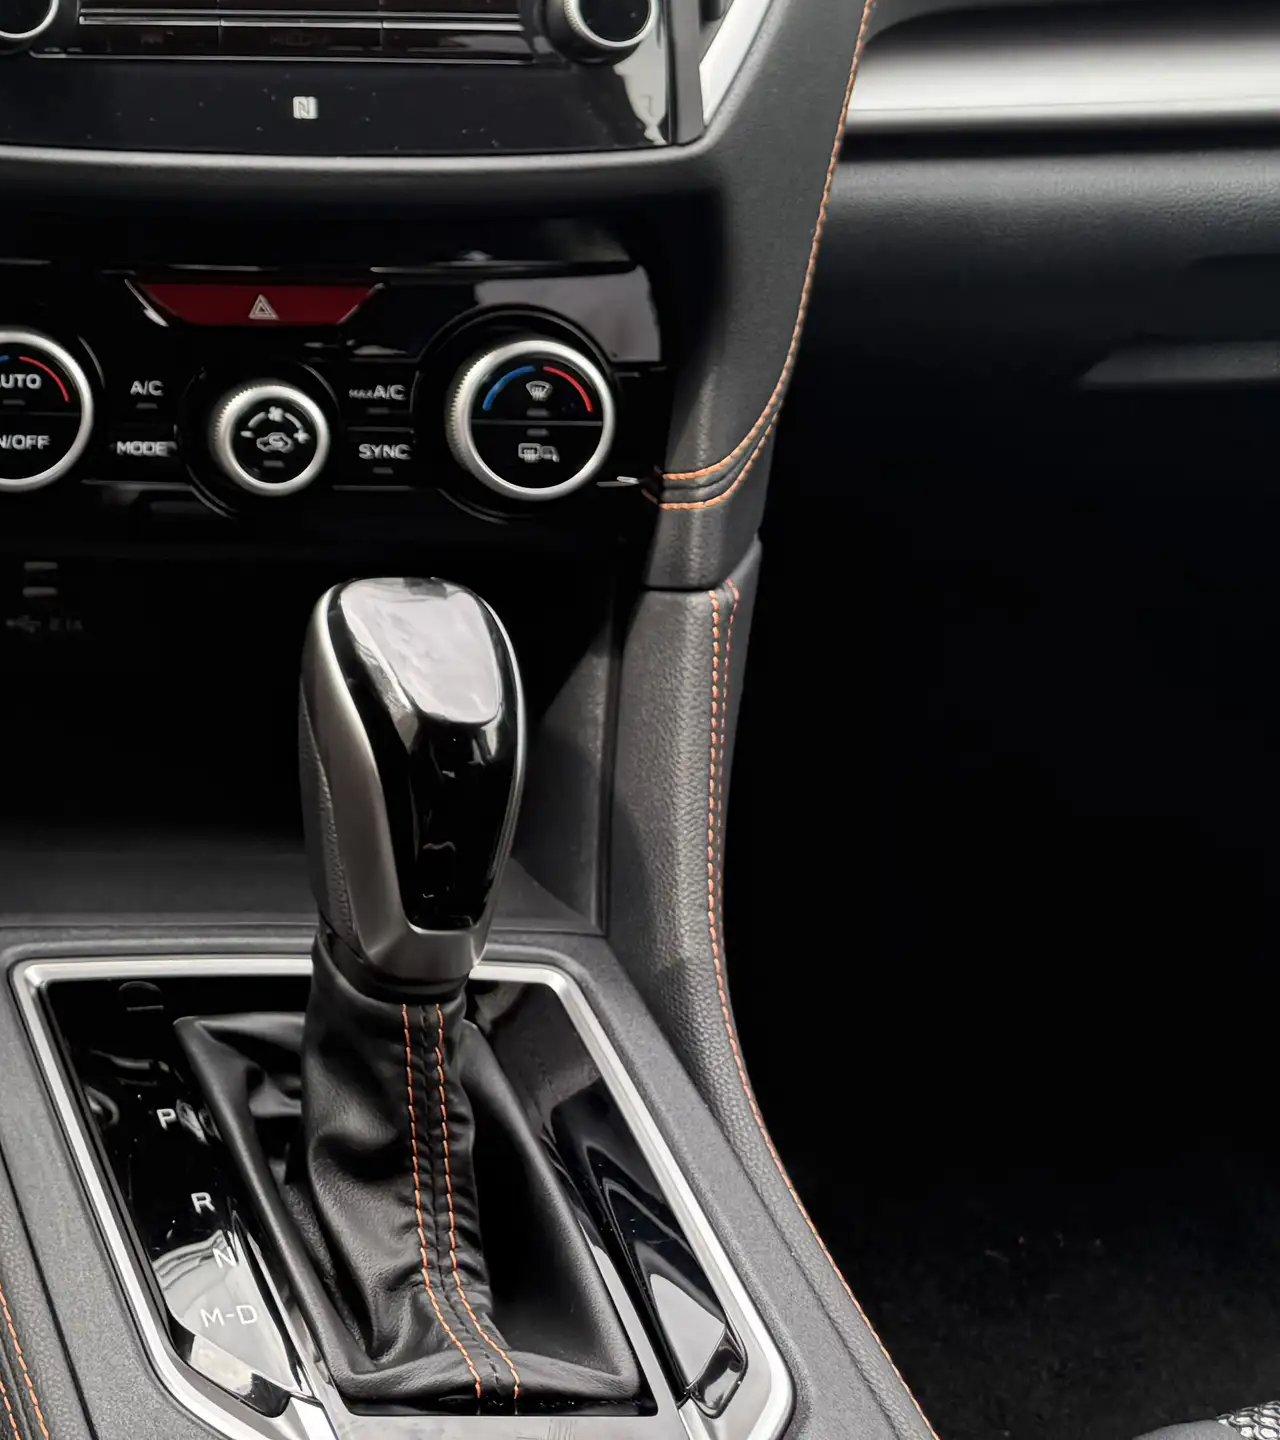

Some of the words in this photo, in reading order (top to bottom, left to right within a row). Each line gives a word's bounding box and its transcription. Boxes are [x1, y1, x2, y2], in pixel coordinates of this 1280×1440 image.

[130, 381, 164, 396] A/C
[116, 441, 170, 456] MODE
[358, 444, 412, 460] SYNC
[156, 1108, 177, 1130] P
[191, 1192, 215, 1213] R
[213, 1246, 238, 1268] N
[199, 1304, 259, 1327] M-D
